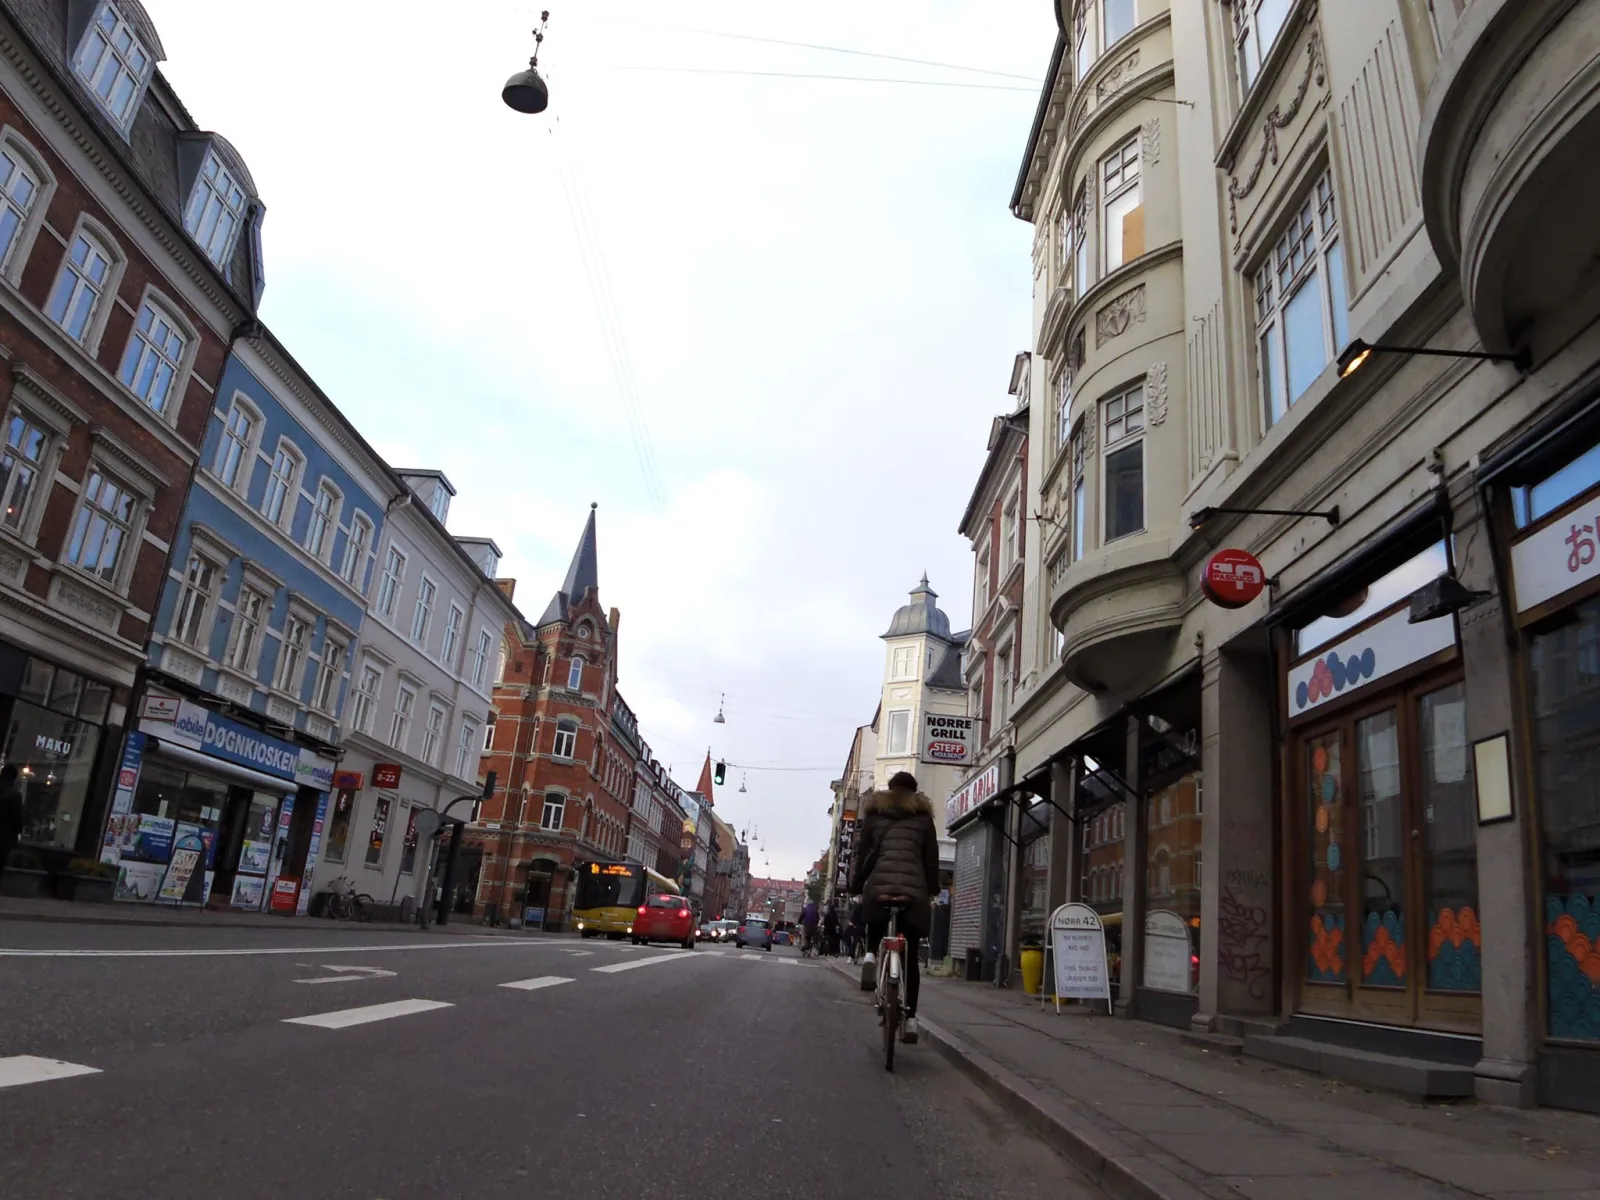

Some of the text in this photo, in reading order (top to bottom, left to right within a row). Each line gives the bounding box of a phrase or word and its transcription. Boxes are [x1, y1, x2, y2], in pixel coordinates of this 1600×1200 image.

[1213, 573, 1255, 583] PASCUCCI
[927, 717, 972, 729] NØRRE
[931, 728, 966, 739] GRILL
[35, 735, 71, 754] MAKU
[204, 722, 298, 773] DØGNKIOSKEN
[934, 742, 962, 753] STEFF
[376, 773, 396, 782] 8-22
[972, 768, 996, 807] GRILL
[1058, 916, 1096, 926] NØRR 42
